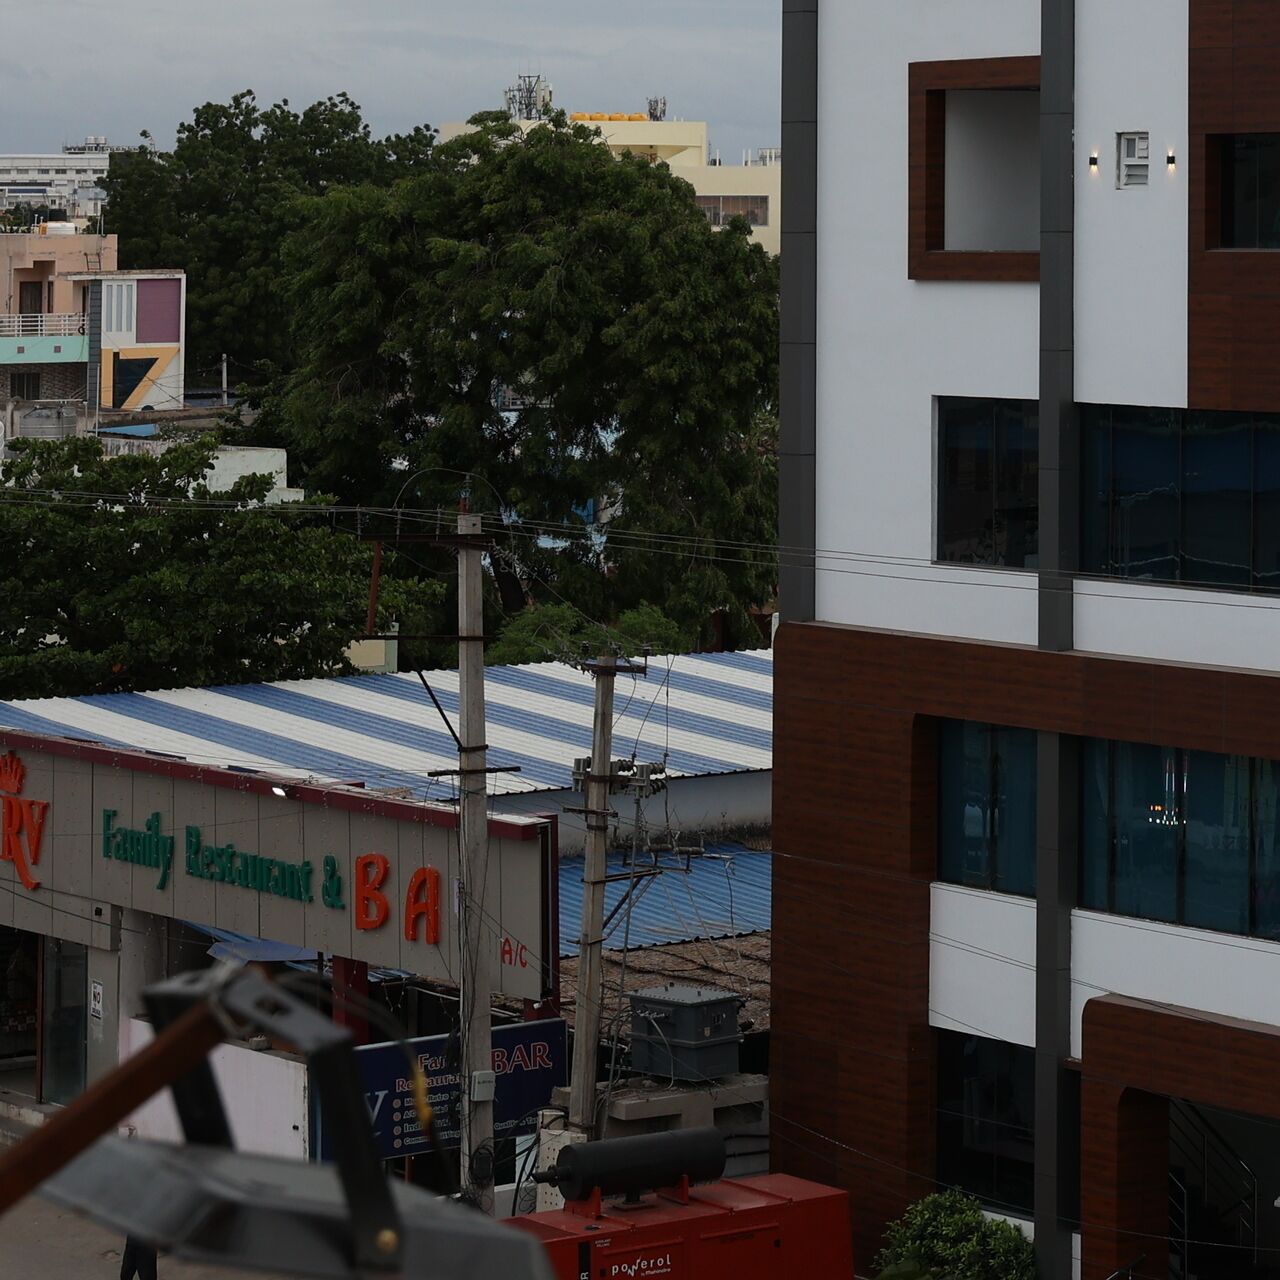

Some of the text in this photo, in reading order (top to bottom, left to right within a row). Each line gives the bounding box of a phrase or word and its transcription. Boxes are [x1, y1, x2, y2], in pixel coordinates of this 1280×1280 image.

[103, 808, 441, 945] Family Restaurant & BA
[501, 937, 528, 968] A/C
[491, 1041, 553, 1076] BAR
